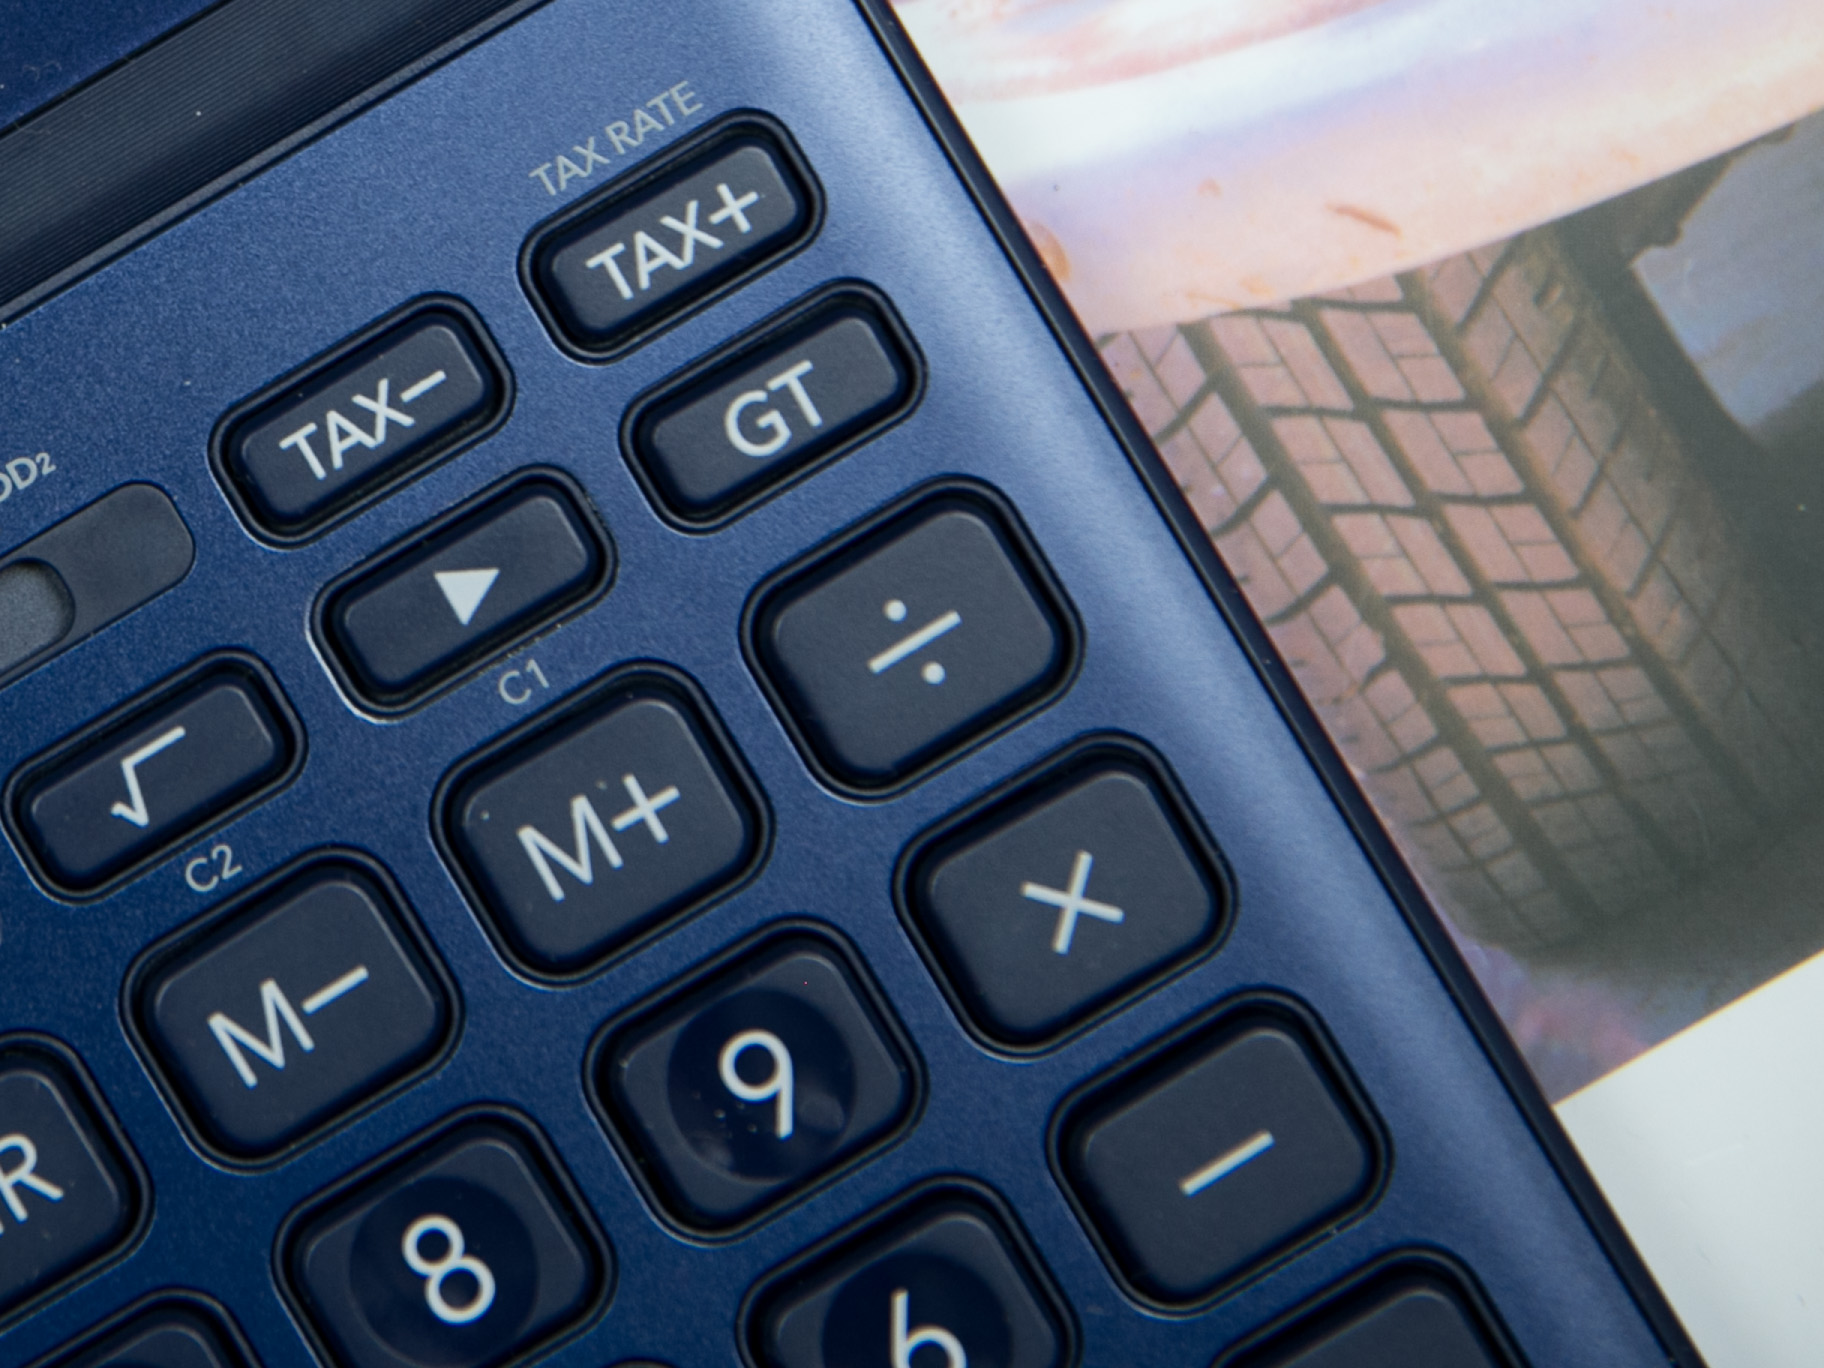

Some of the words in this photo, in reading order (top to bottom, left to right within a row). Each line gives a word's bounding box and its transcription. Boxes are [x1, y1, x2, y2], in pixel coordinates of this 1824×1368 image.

[529, 138, 610, 198] TAX
[606, 80, 703, 158] RATE
[586, 183, 759, 299] TAX+
[725, 360, 822, 456] GT
[499, 659, 549, 705] C1
[185, 844, 242, 892] C2
[518, 775, 679, 900] M+
[720, 1031, 793, 1137] 9
[403, 1216, 495, 1323] 8
[892, 1292, 966, 1368] 6
